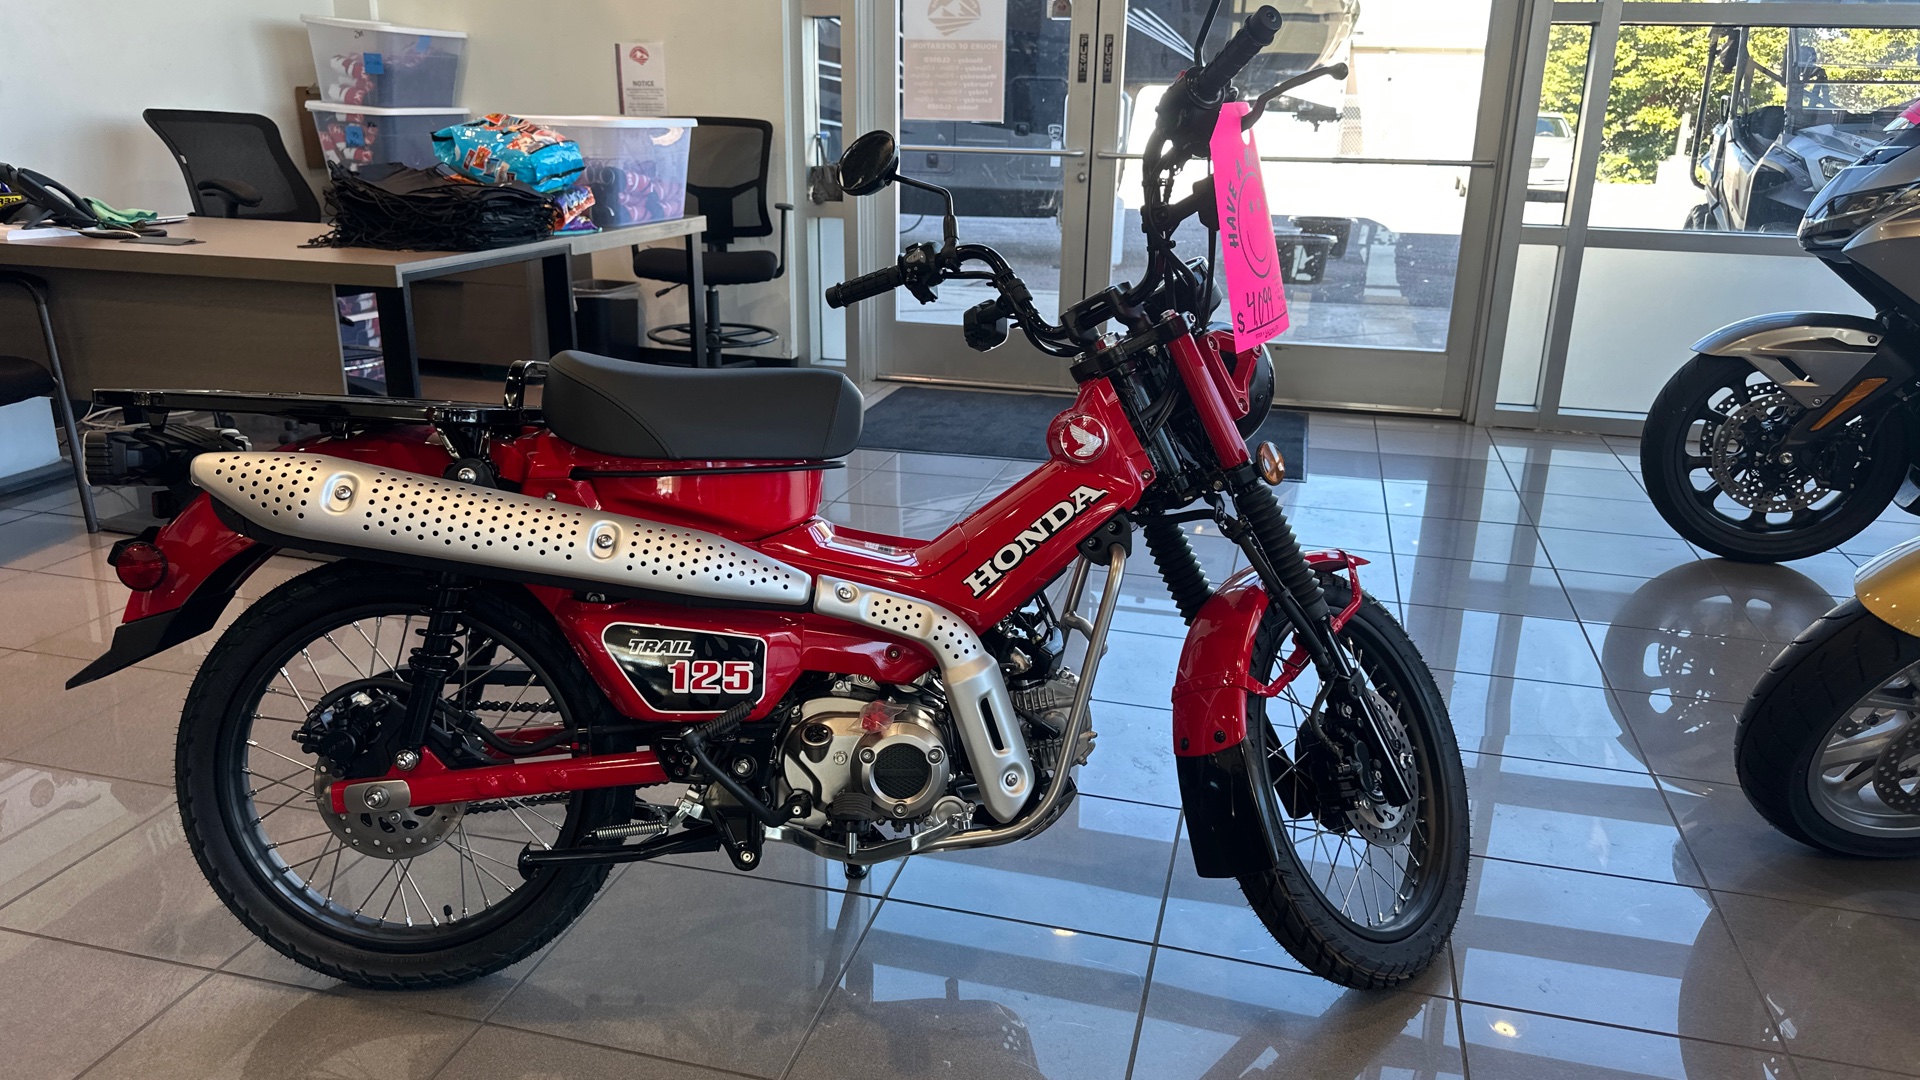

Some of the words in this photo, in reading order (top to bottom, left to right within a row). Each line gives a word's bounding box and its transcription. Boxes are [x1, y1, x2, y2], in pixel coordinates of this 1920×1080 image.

[1080, 38, 1088, 71] PUSH
[1104, 38, 1112, 71] PUSH
[1226, 179, 1239, 248] HAVE
[1235, 158, 1243, 180] A
[1237, 311, 1246, 336] $
[962, 485, 1109, 598] HONDA
[629, 639, 695, 656] TRAIL
[667, 659, 755, 694] 125
